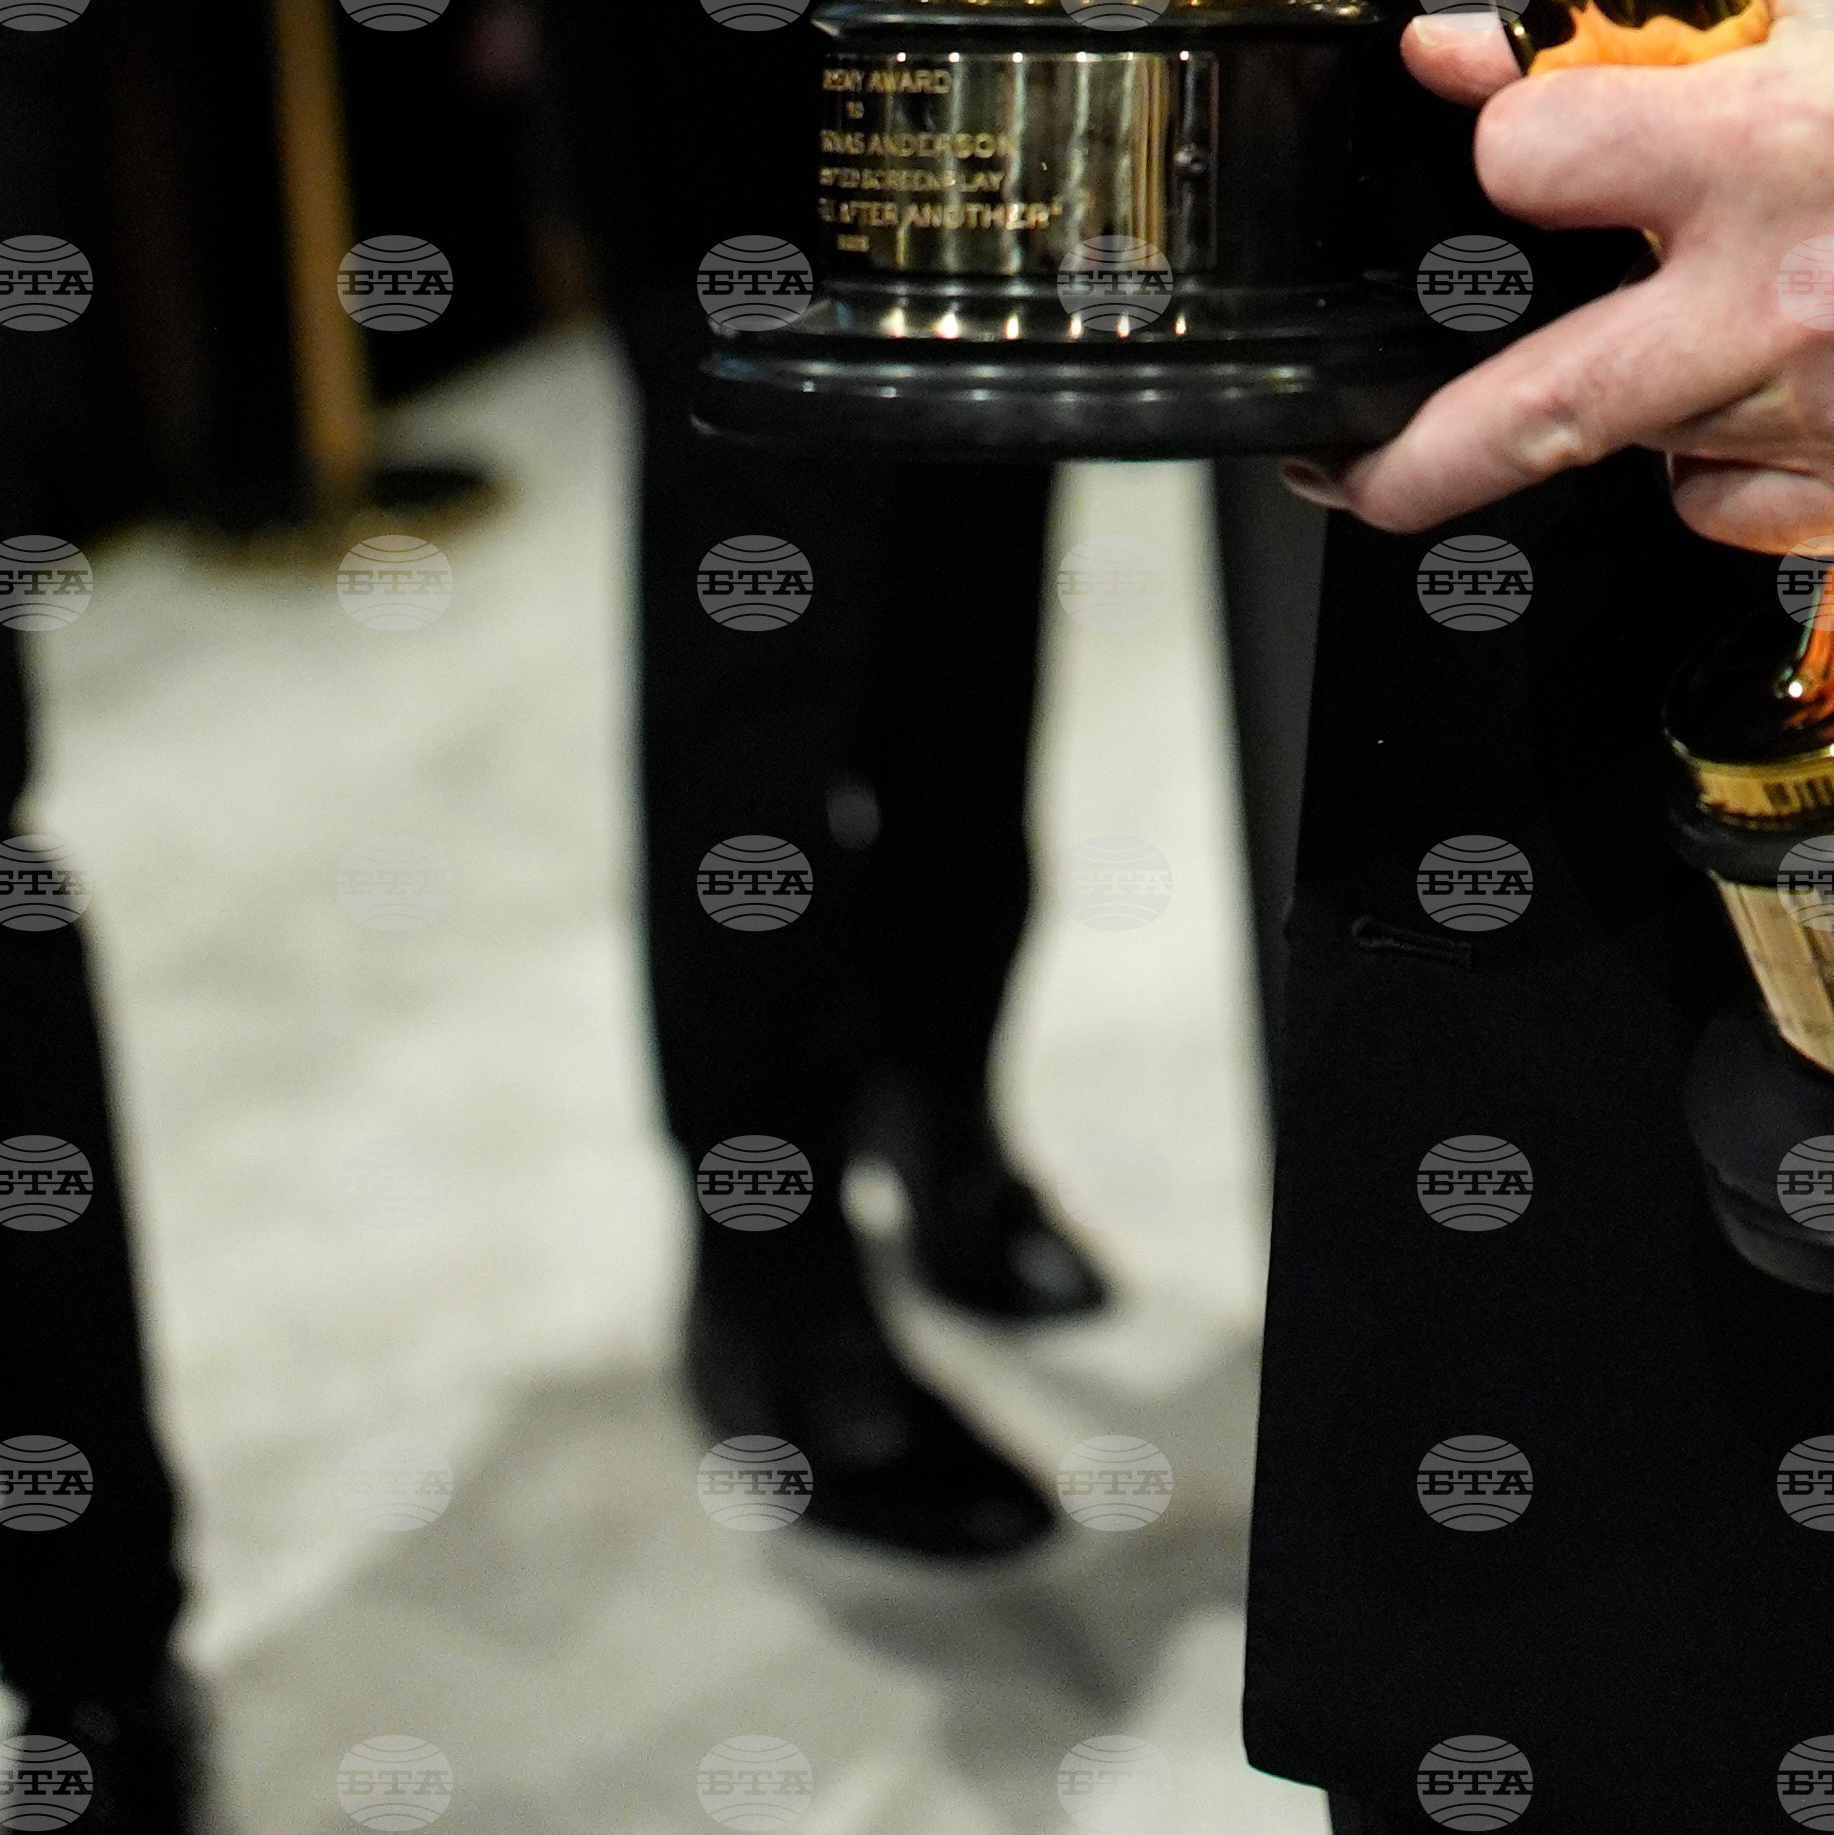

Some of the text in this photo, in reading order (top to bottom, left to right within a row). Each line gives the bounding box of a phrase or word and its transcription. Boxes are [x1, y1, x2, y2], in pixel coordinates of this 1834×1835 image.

[867, 69, 949, 93] AWARD
[867, 132, 1015, 159] ANDERSON
[838, 201, 899, 226] AFTER
